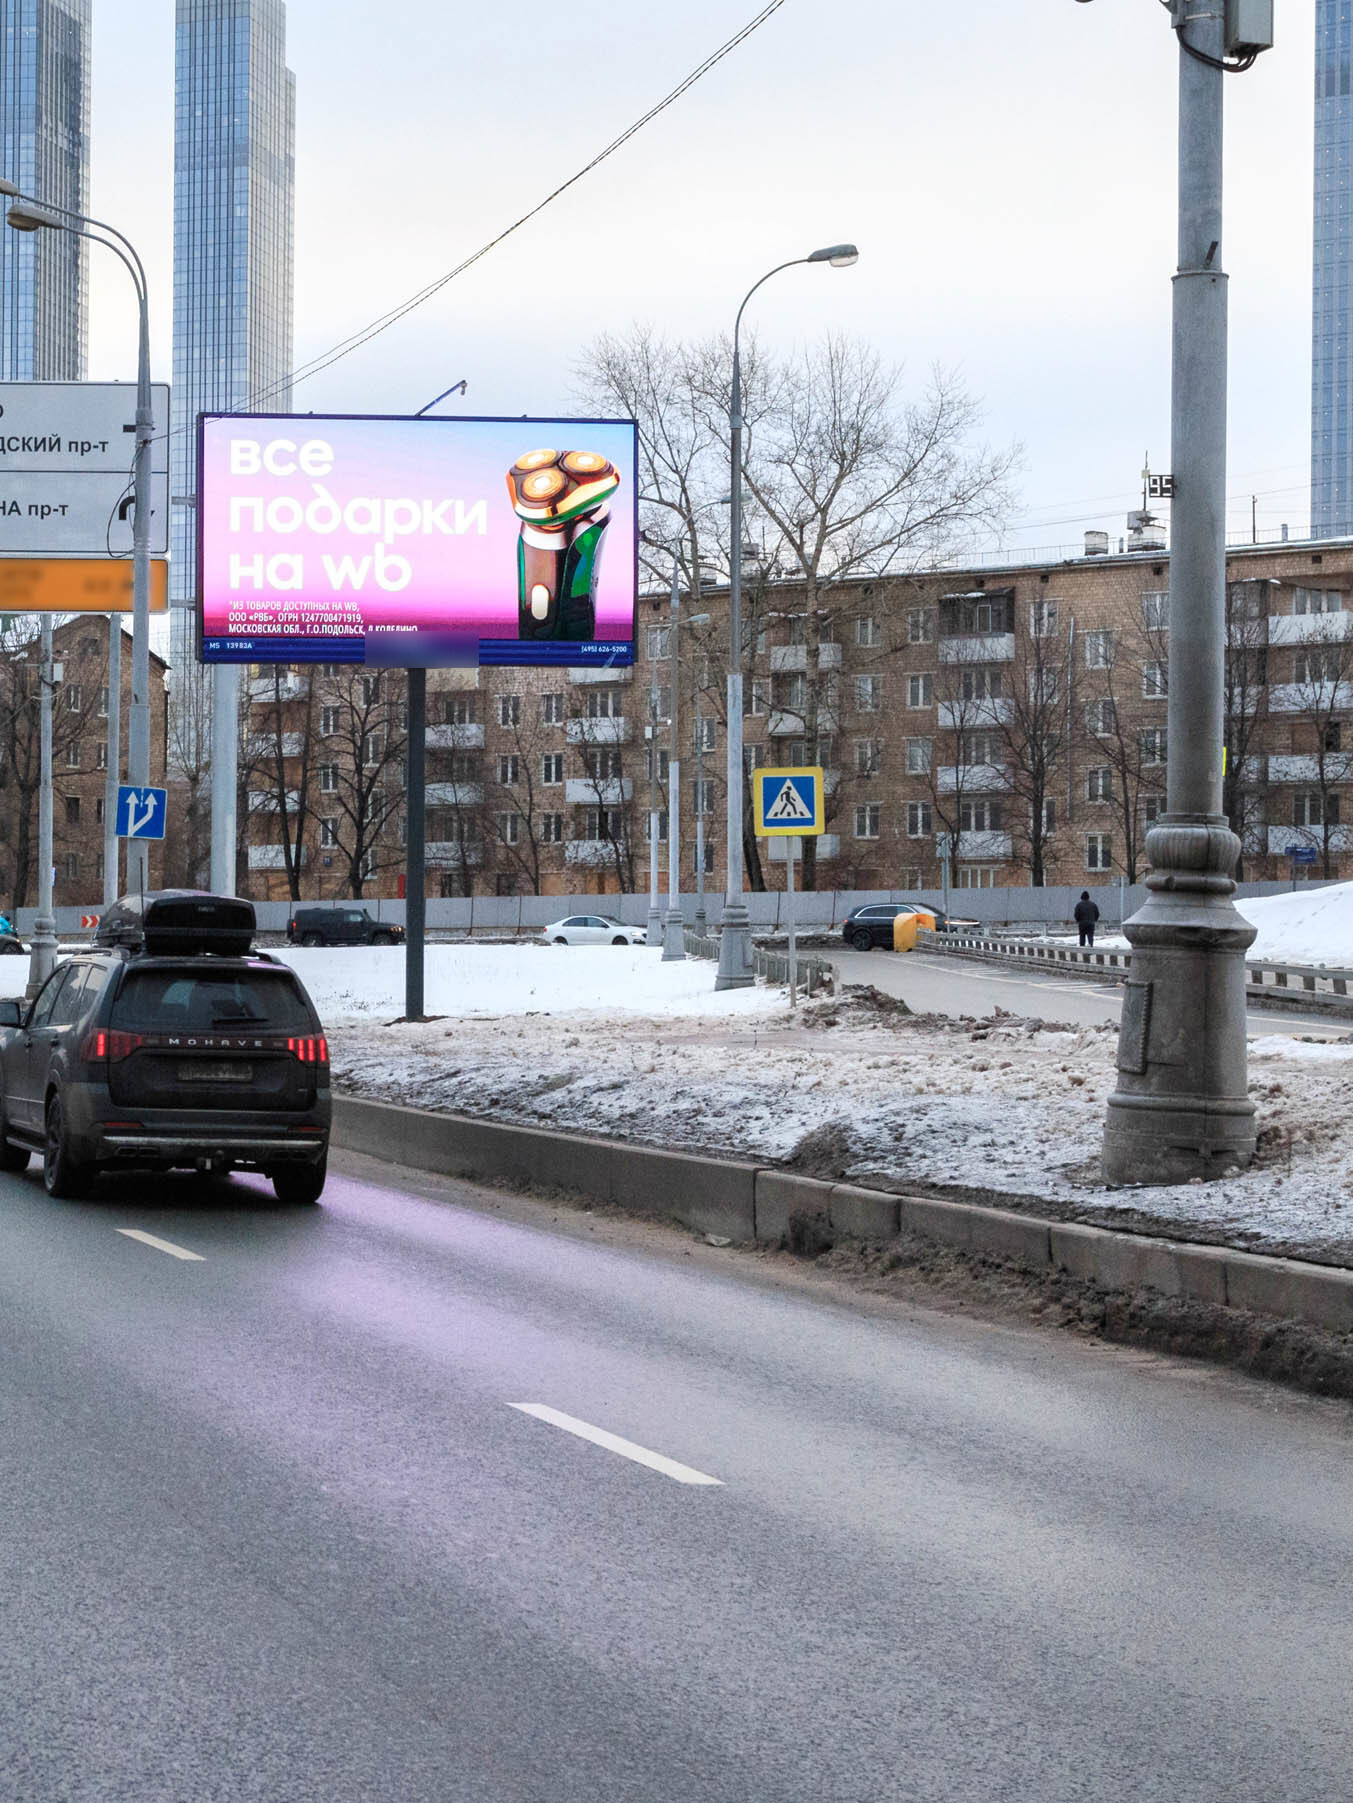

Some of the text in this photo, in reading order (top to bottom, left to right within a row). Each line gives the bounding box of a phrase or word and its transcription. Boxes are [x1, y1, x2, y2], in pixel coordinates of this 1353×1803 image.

[69, 440, 109, 456] пр-т
[230, 438, 334, 476] все
[1149, 476, 1172, 496] 95
[28, 504, 69, 520] пр-т
[230, 483, 488, 544] подарки
[230, 543, 412, 592] на wb
[246, 601, 281, 611] ТОВАРОВ
[283, 601, 330, 612] ДОСТУПНЫХ
[332, 602, 342, 611] НА
[344, 602, 360, 612] WB,
[229, 612, 247, 622] ООО
[278, 613, 298, 622] ОГРН
[229, 623, 281, 634] МОСКОВСКАЯ
[283, 624, 305, 635] ОБЛ.,
[168, 1038, 263, 1047] MOHAVE
